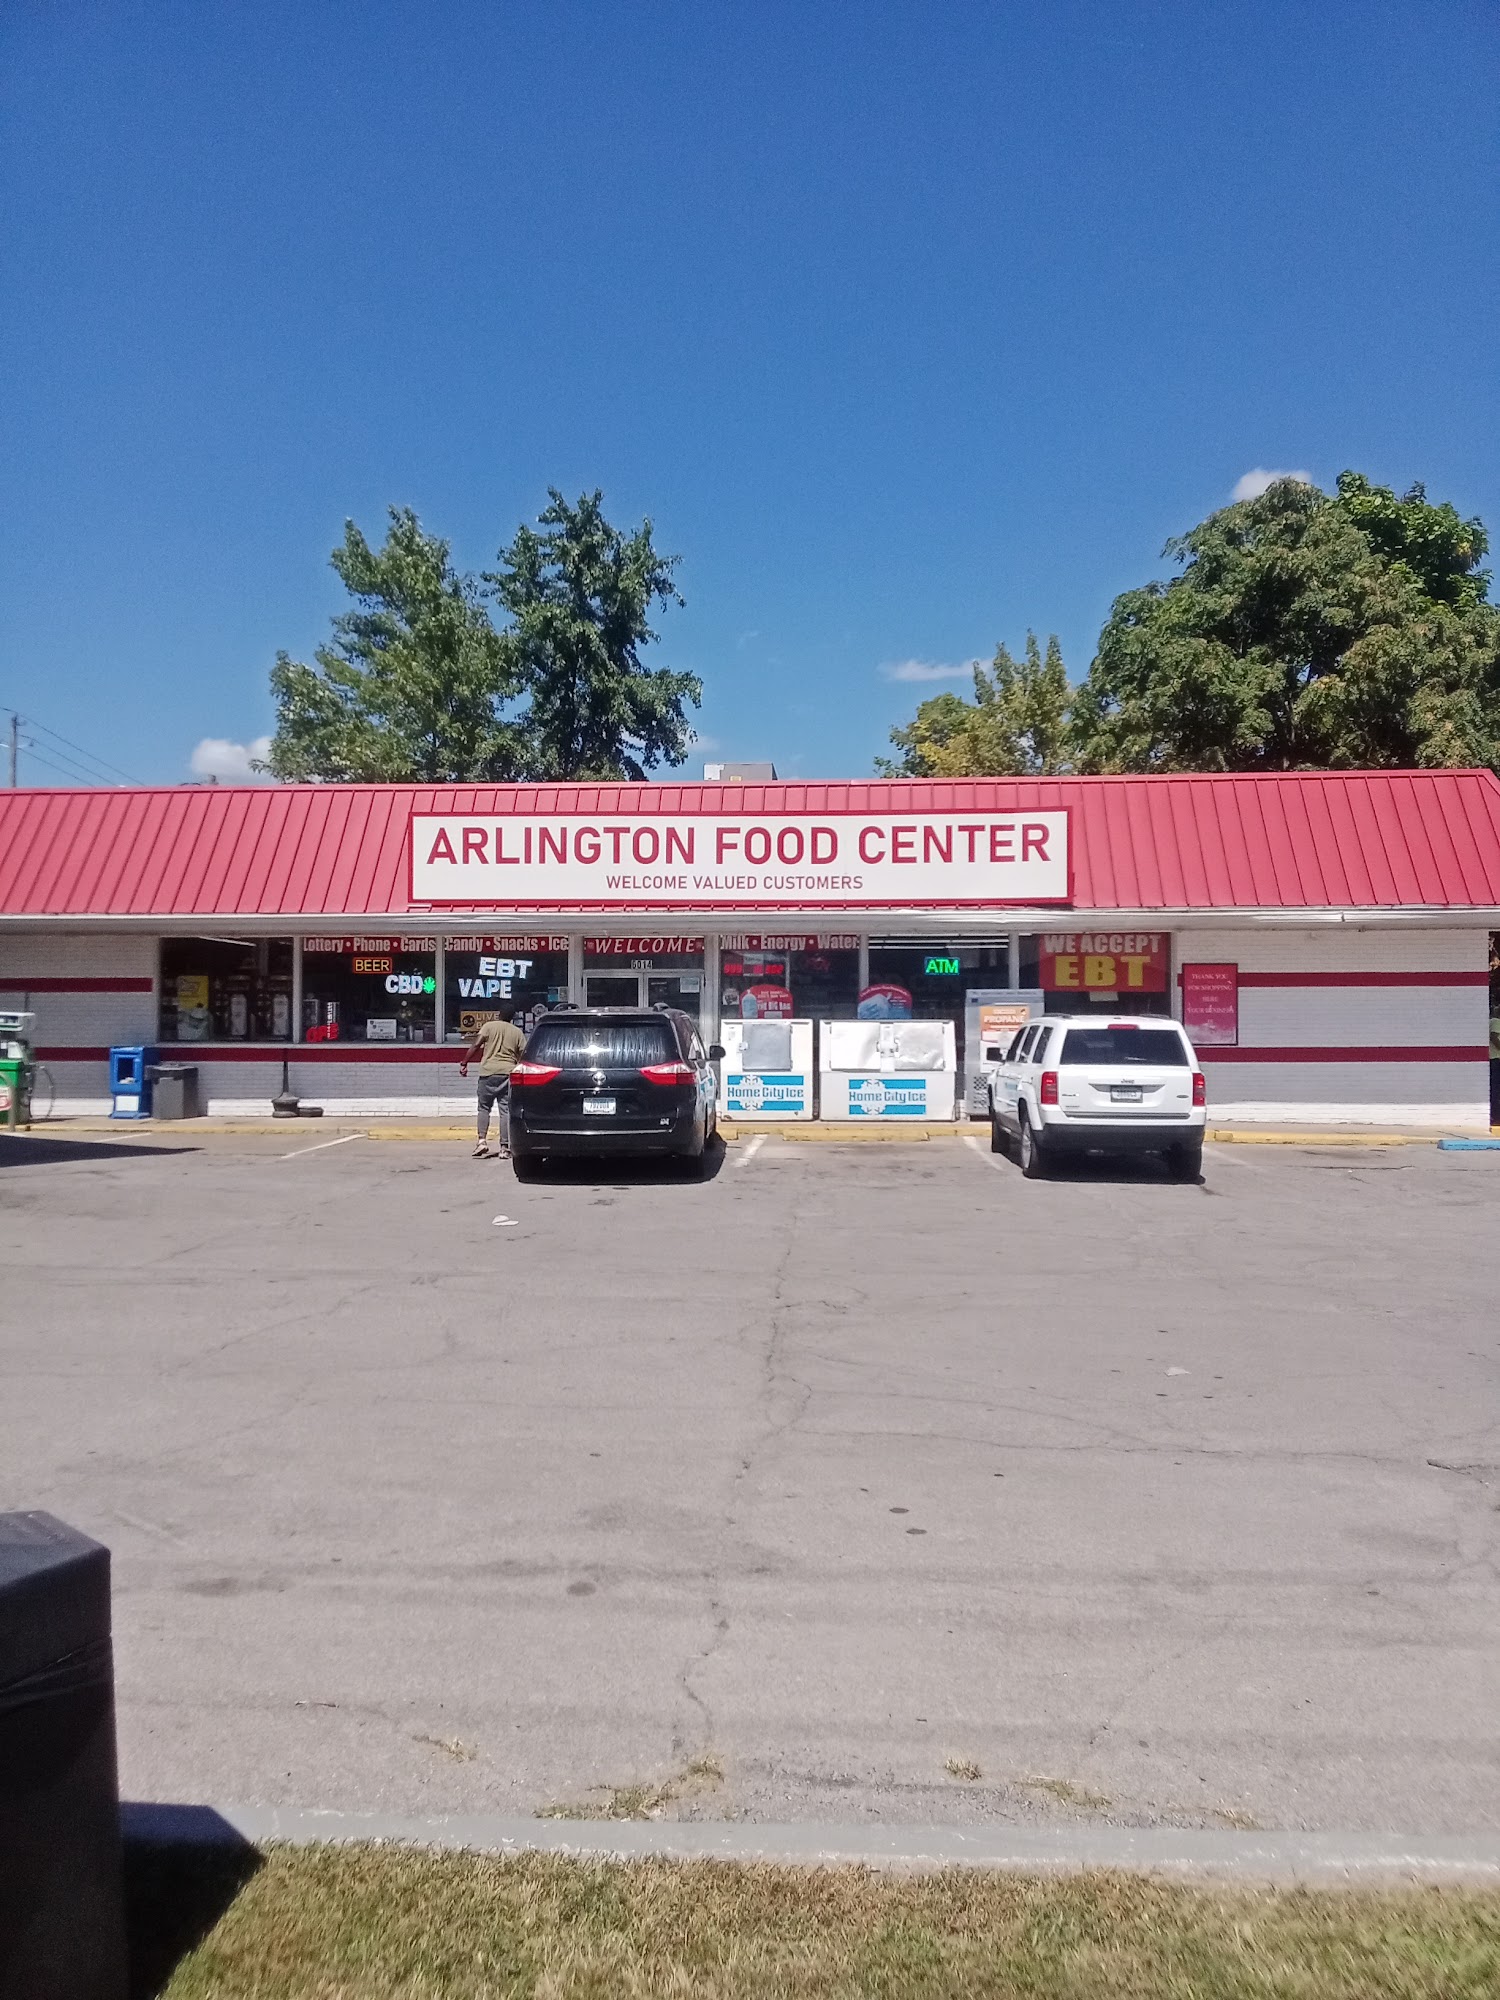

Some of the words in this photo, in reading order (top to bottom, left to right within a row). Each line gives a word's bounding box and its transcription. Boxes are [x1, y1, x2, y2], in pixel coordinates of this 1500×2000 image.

[426, 826, 695, 865] ARLINGTON
[715, 826, 838, 865] FOOD
[858, 823, 1052, 864] CENTER
[606, 876, 688, 889] WELCOME
[692, 875, 757, 889] VALUED
[763, 875, 863, 890] CUSTOMERS
[303, 938, 343, 953] Lottery
[353, 938, 391, 952] Phone
[400, 937, 437, 952] Cards
[447, 938, 483, 952] Candy
[493, 938, 539, 951] Snacks
[548, 937, 568, 951] Ice
[595, 938, 696, 953] WELCOME
[721, 935, 749, 950] Milk
[760, 936, 806, 951] Energy
[817, 935, 856, 950] Water
[1044, 935, 1077, 953] WE
[1080, 934, 1161, 953] ACCEPT
[355, 959, 390, 972] BEER
[479, 957, 533, 979] EBT
[925, 958, 959, 974] ATM
[1055, 955, 1150, 987] EBT
[385, 975, 424, 994] CBD
[458, 978, 512, 999] VAPE
[476, 1013, 500, 1021] LIVE
[984, 1015, 1025, 1023] PROPANE
[727, 1087, 760, 1098] Home
[762, 1087, 784, 1099] City
[785, 1087, 804, 1098] Ice
[849, 1091, 883, 1102] Home
[884, 1091, 907, 1103] City
[908, 1091, 926, 1102] Ice
